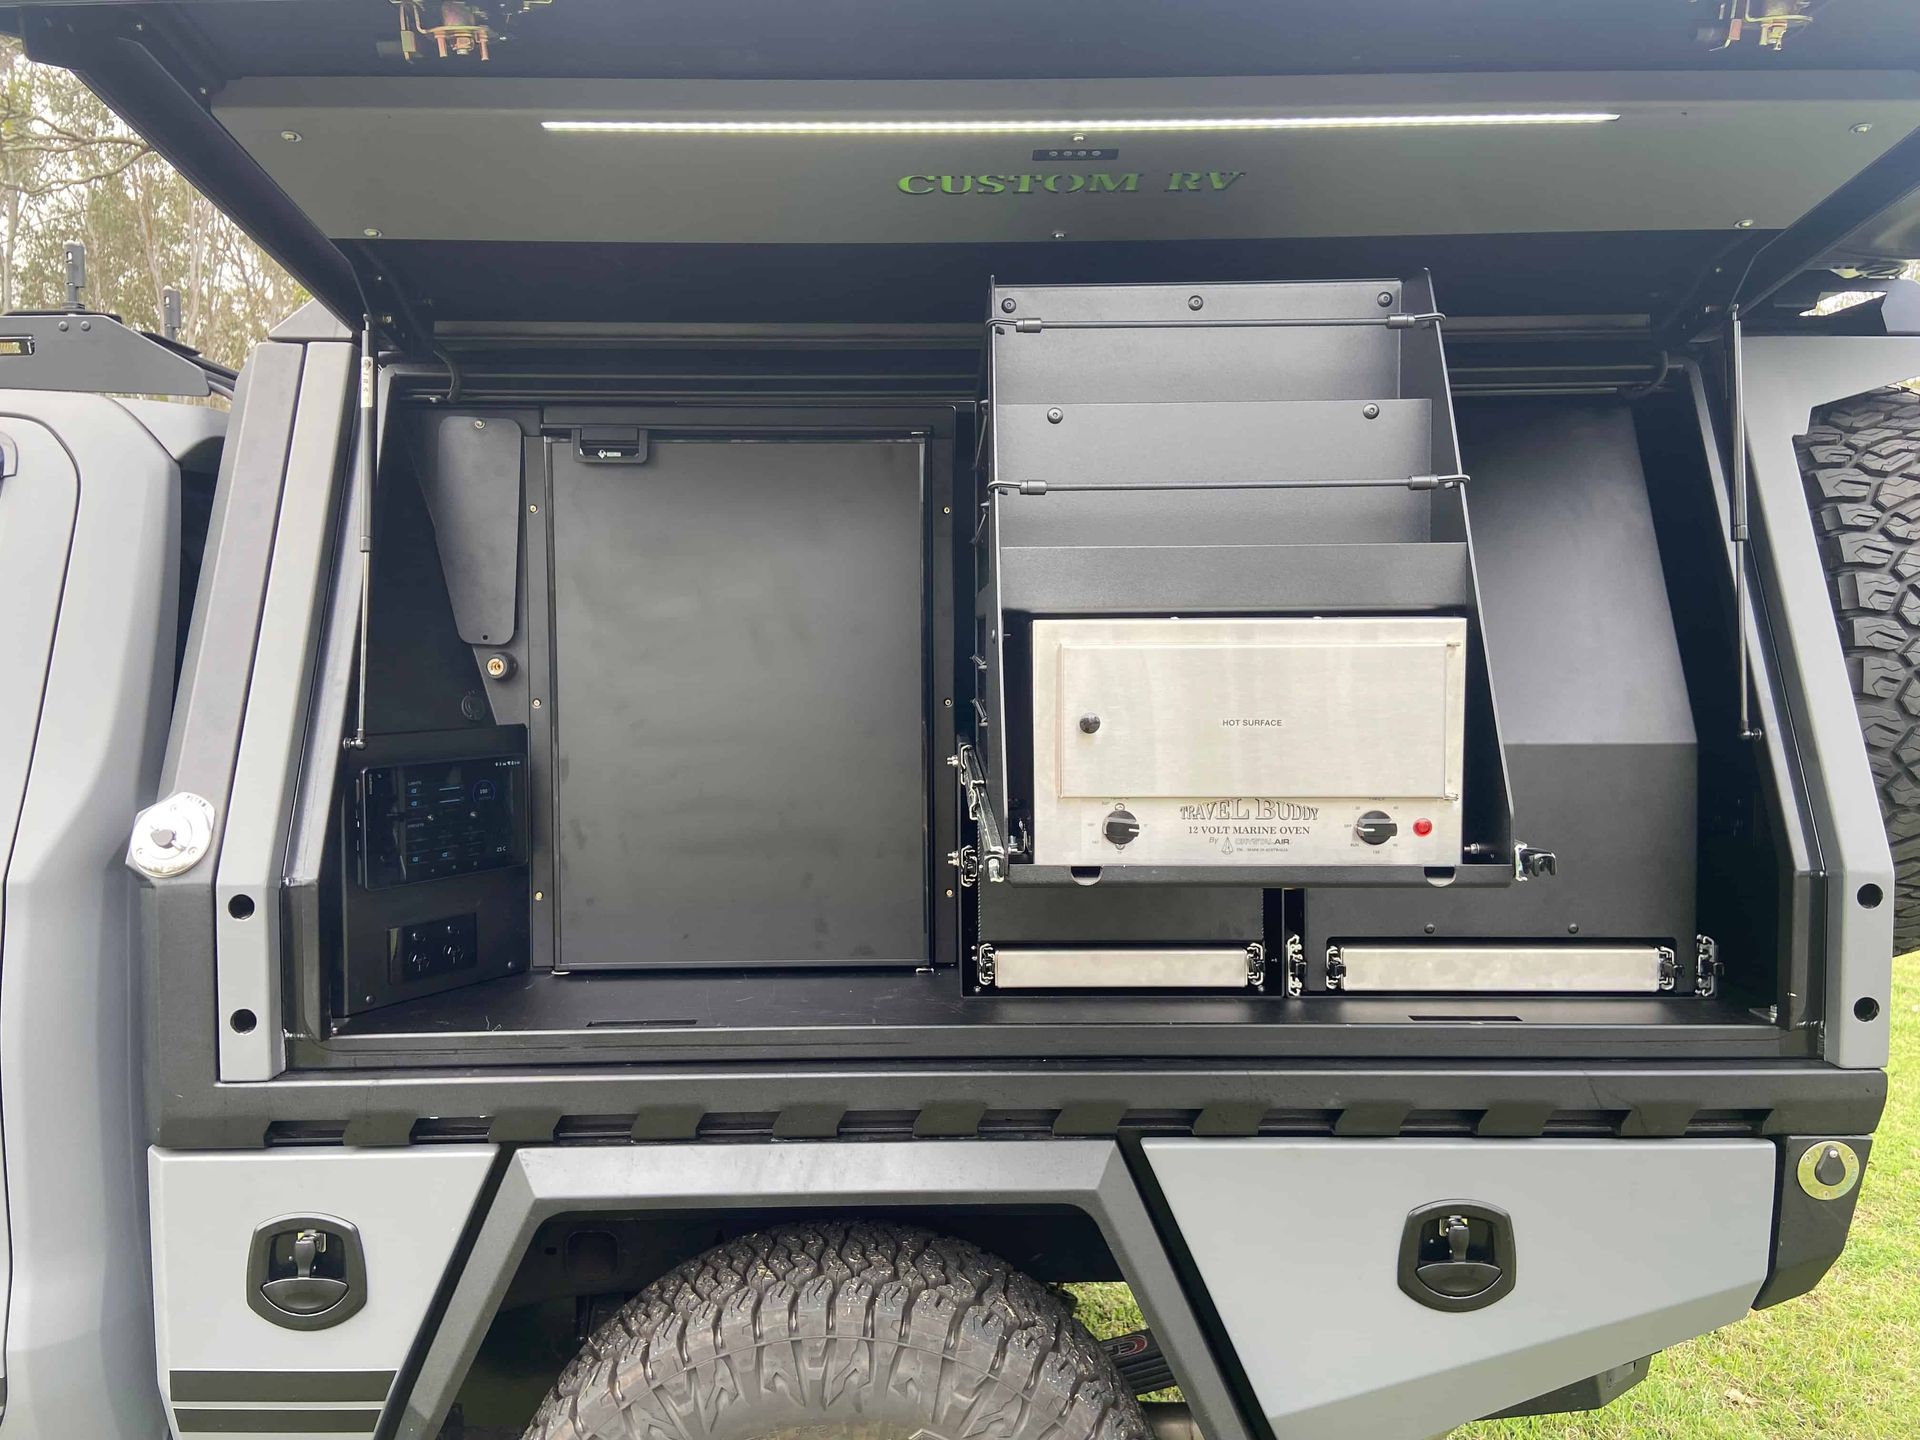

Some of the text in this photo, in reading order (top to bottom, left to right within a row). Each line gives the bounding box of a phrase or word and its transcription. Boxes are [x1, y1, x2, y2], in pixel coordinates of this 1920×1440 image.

[896, 171, 1246, 195] CUSTOM RV
[1222, 719, 1283, 727] HOT SURFACE
[1180, 798, 1250, 821] TRAVEL
[1188, 826, 1311, 835] 12 VOLT MARINE OVEN
[1208, 836, 1219, 845] By
